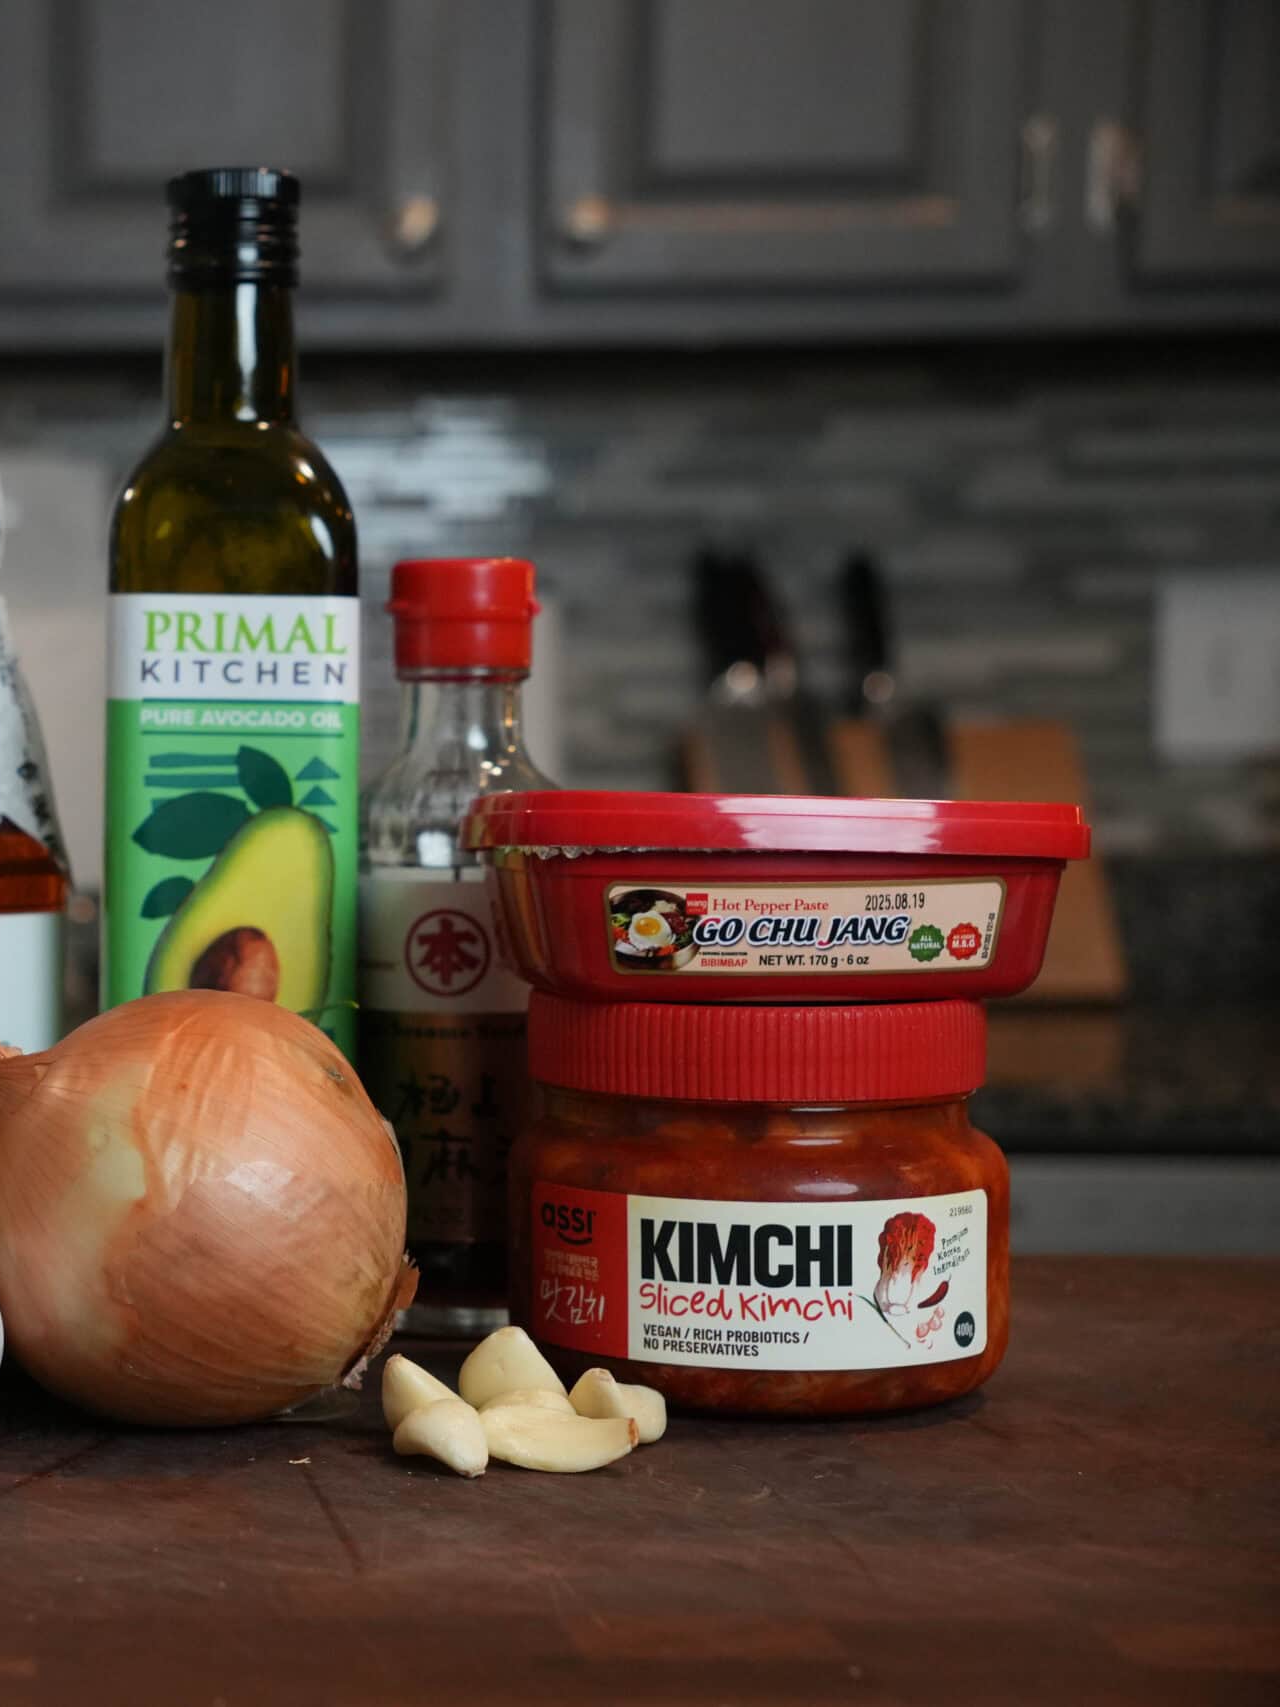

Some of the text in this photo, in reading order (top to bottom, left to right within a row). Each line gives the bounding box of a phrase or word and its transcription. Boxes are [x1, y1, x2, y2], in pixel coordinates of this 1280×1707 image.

[144, 612, 347, 654] PRIMAL
[141, 660, 346, 685] KITCHEN
[140, 709, 342, 728] PURE AVOCADO OIL
[713, 899, 740, 911] Hot
[745, 899, 791, 914] Pepper
[794, 899, 829, 911] Paste
[865, 893, 925, 911] 2025.08.19
[694, 917, 908, 946] GO CHU JANG
[701, 958, 748, 967] BIBIMBAP
[759, 955, 869, 968] NET WT. 170 g 6 oz
[641, 1218, 852, 1288] KIMCHI
[640, 1283, 853, 1321] Sliced Kimchi
[643, 1324, 681, 1338] VEGAN
[693, 1328, 721, 1341] RICH
[727, 1330, 800, 1344] PROBIOTICS
[644, 1338, 759, 1357] NO PRESERVATIVES
